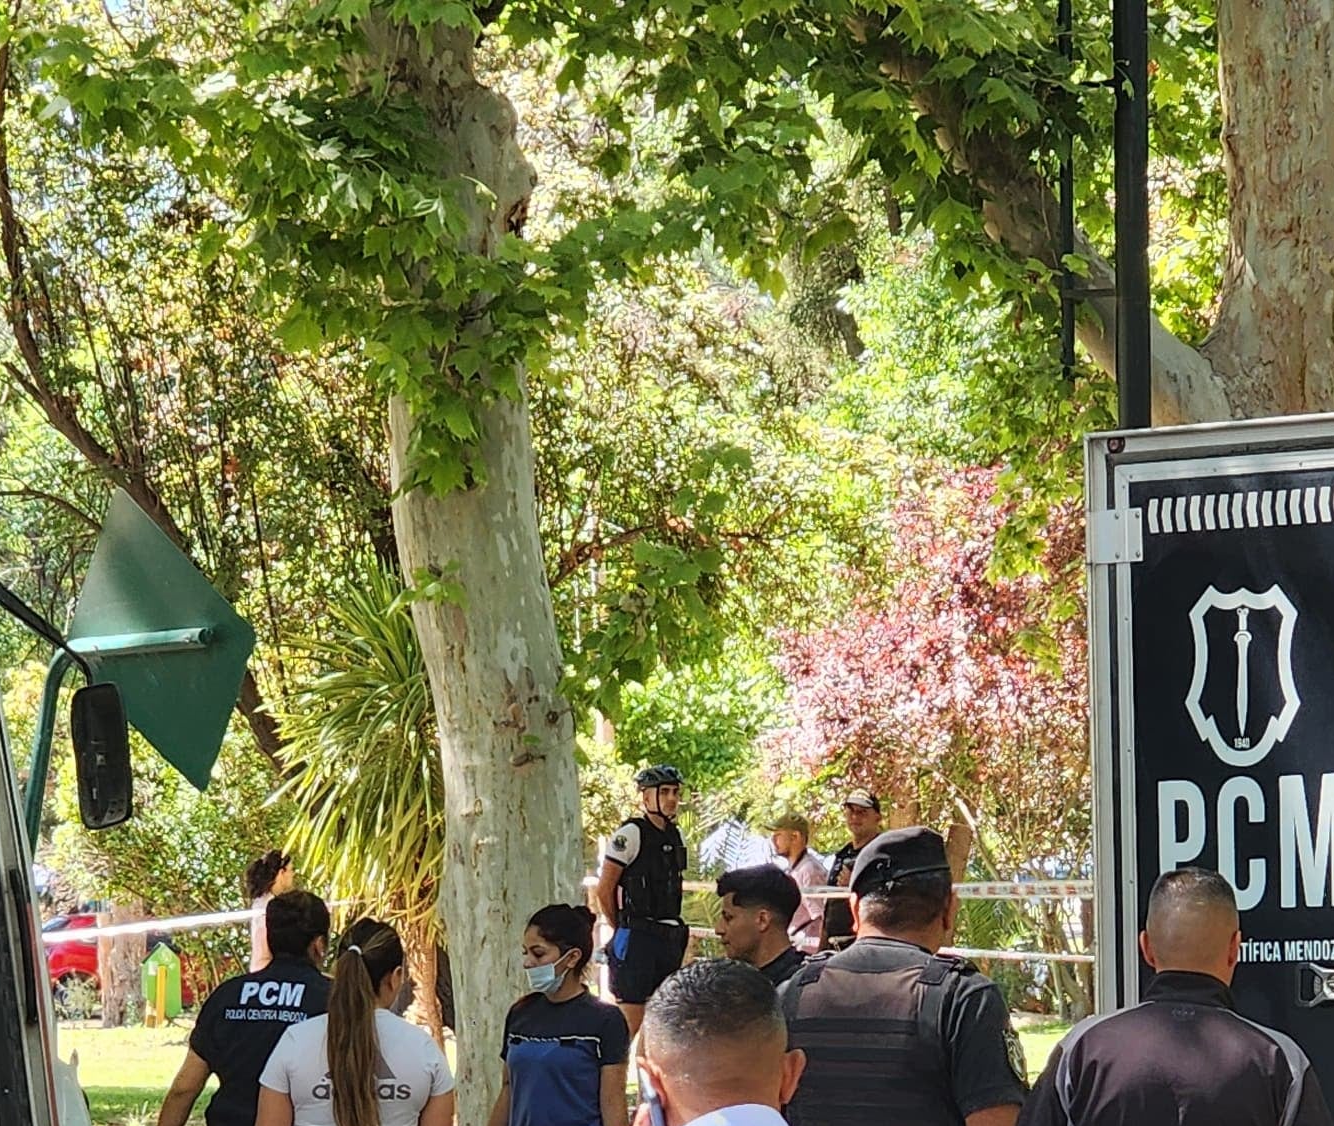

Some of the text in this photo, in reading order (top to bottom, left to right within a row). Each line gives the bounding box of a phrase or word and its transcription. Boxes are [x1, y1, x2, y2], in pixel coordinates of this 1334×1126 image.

[1237, 937, 1282, 962] TÍFICA
[239, 981, 306, 1007] PCM
[312, 1083, 412, 1101] aas
